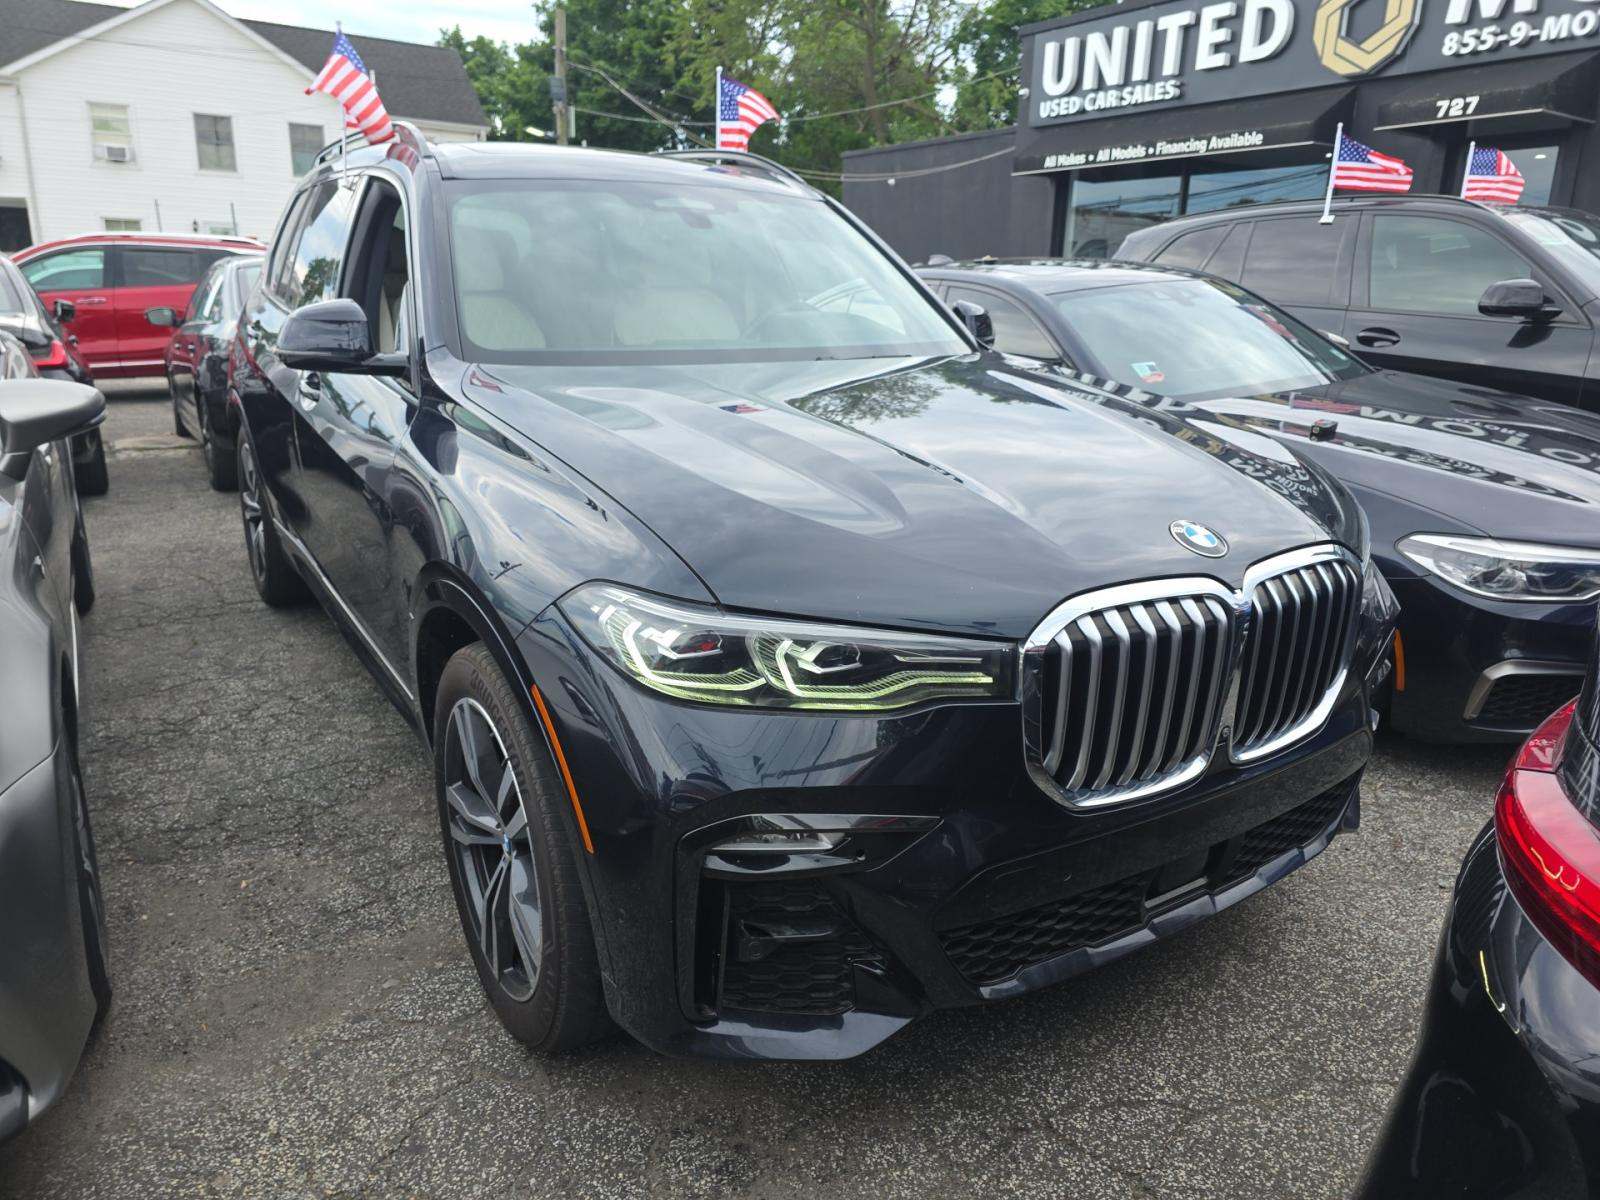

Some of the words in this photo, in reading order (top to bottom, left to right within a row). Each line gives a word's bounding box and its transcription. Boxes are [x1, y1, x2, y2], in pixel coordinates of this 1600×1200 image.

[1042, 0, 1295, 97] UNITED
[1442, 9, 1600, 56] 855-9-MO
[1039, 95, 1081, 118] USED
[1084, 91, 1120, 112] CAR
[1120, 80, 1181, 106] SALES
[1436, 95, 1480, 118] 727
[1044, 156, 1057, 168] All
[1057, 152, 1086, 167] Makes
[1096, 149, 1111, 162] All
[1111, 145, 1147, 160] Models
[1155, 137, 1208, 155] Financing
[1209, 131, 1264, 149] Available
